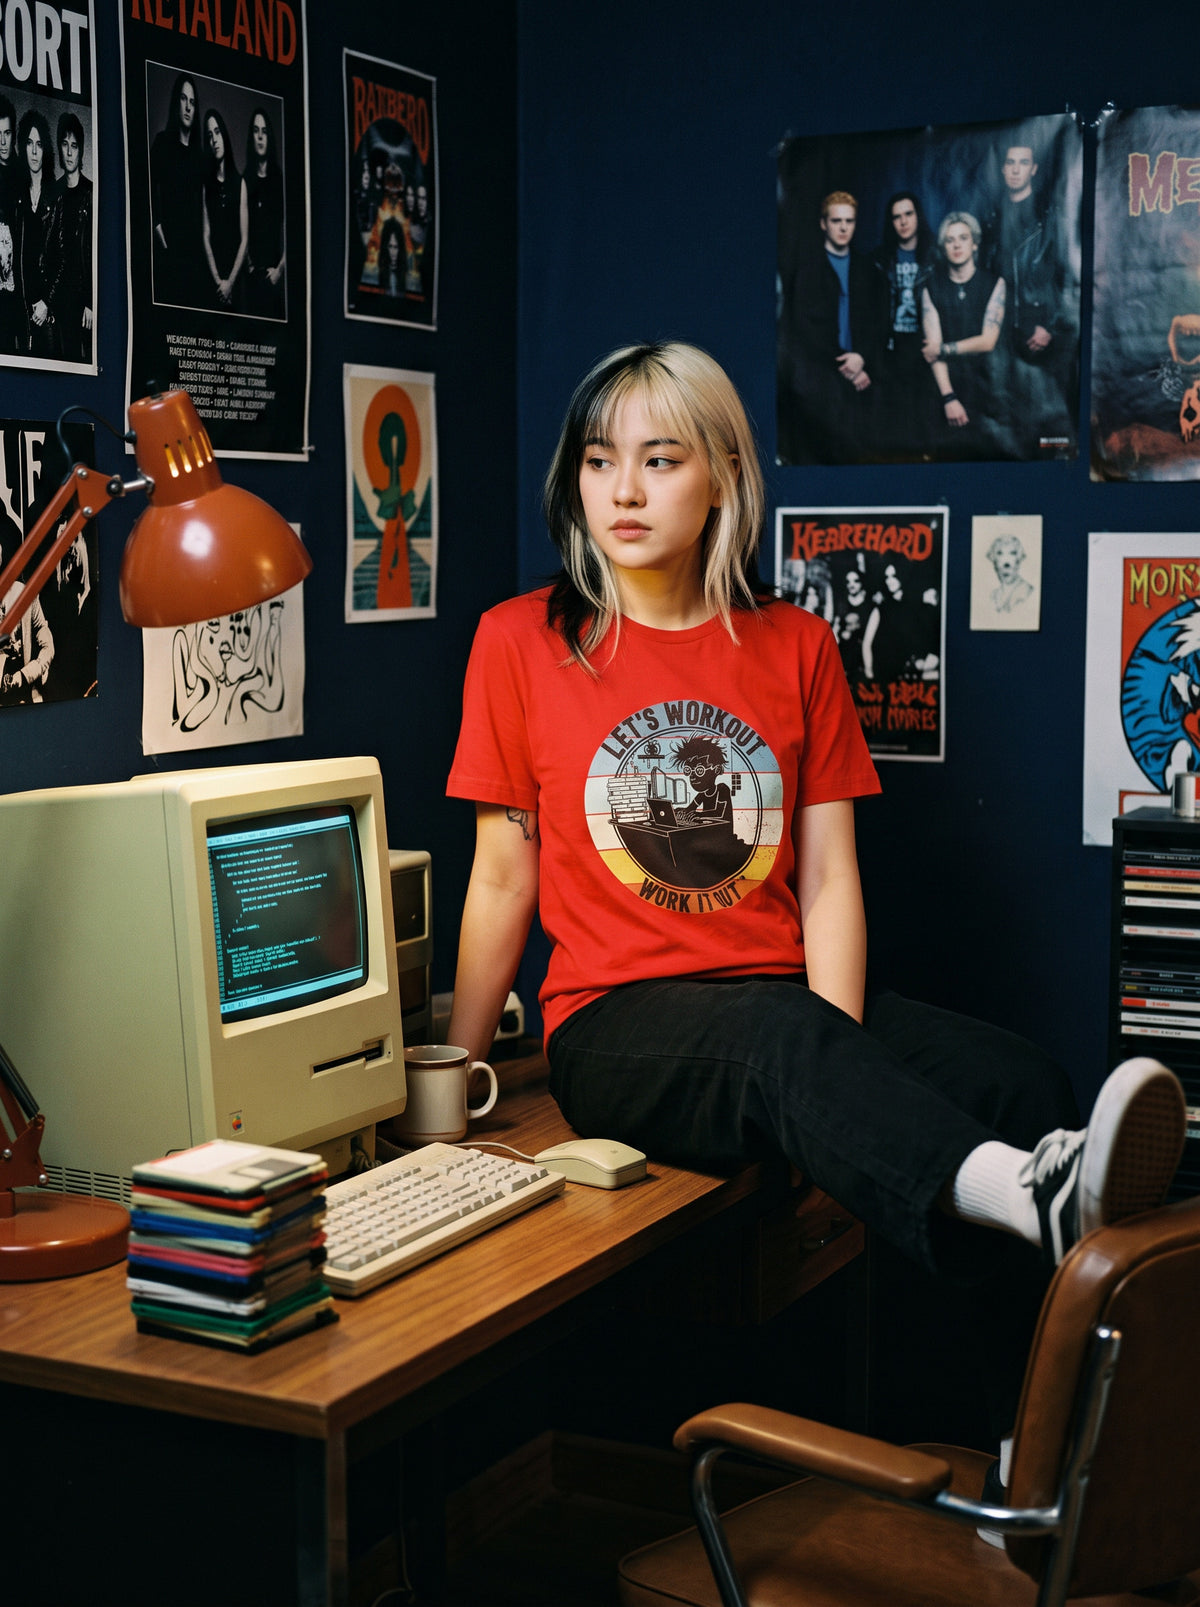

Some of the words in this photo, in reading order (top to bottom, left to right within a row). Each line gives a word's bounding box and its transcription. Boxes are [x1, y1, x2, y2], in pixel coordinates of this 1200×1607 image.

[0, 0, 88, 94] ORT
[600, 707, 659, 760] LET'S
[664, 700, 766, 756] WORKOUT
[639, 877, 690, 913] WORK
[697, 893, 712, 913] IT
[713, 881, 741, 908] OUT
